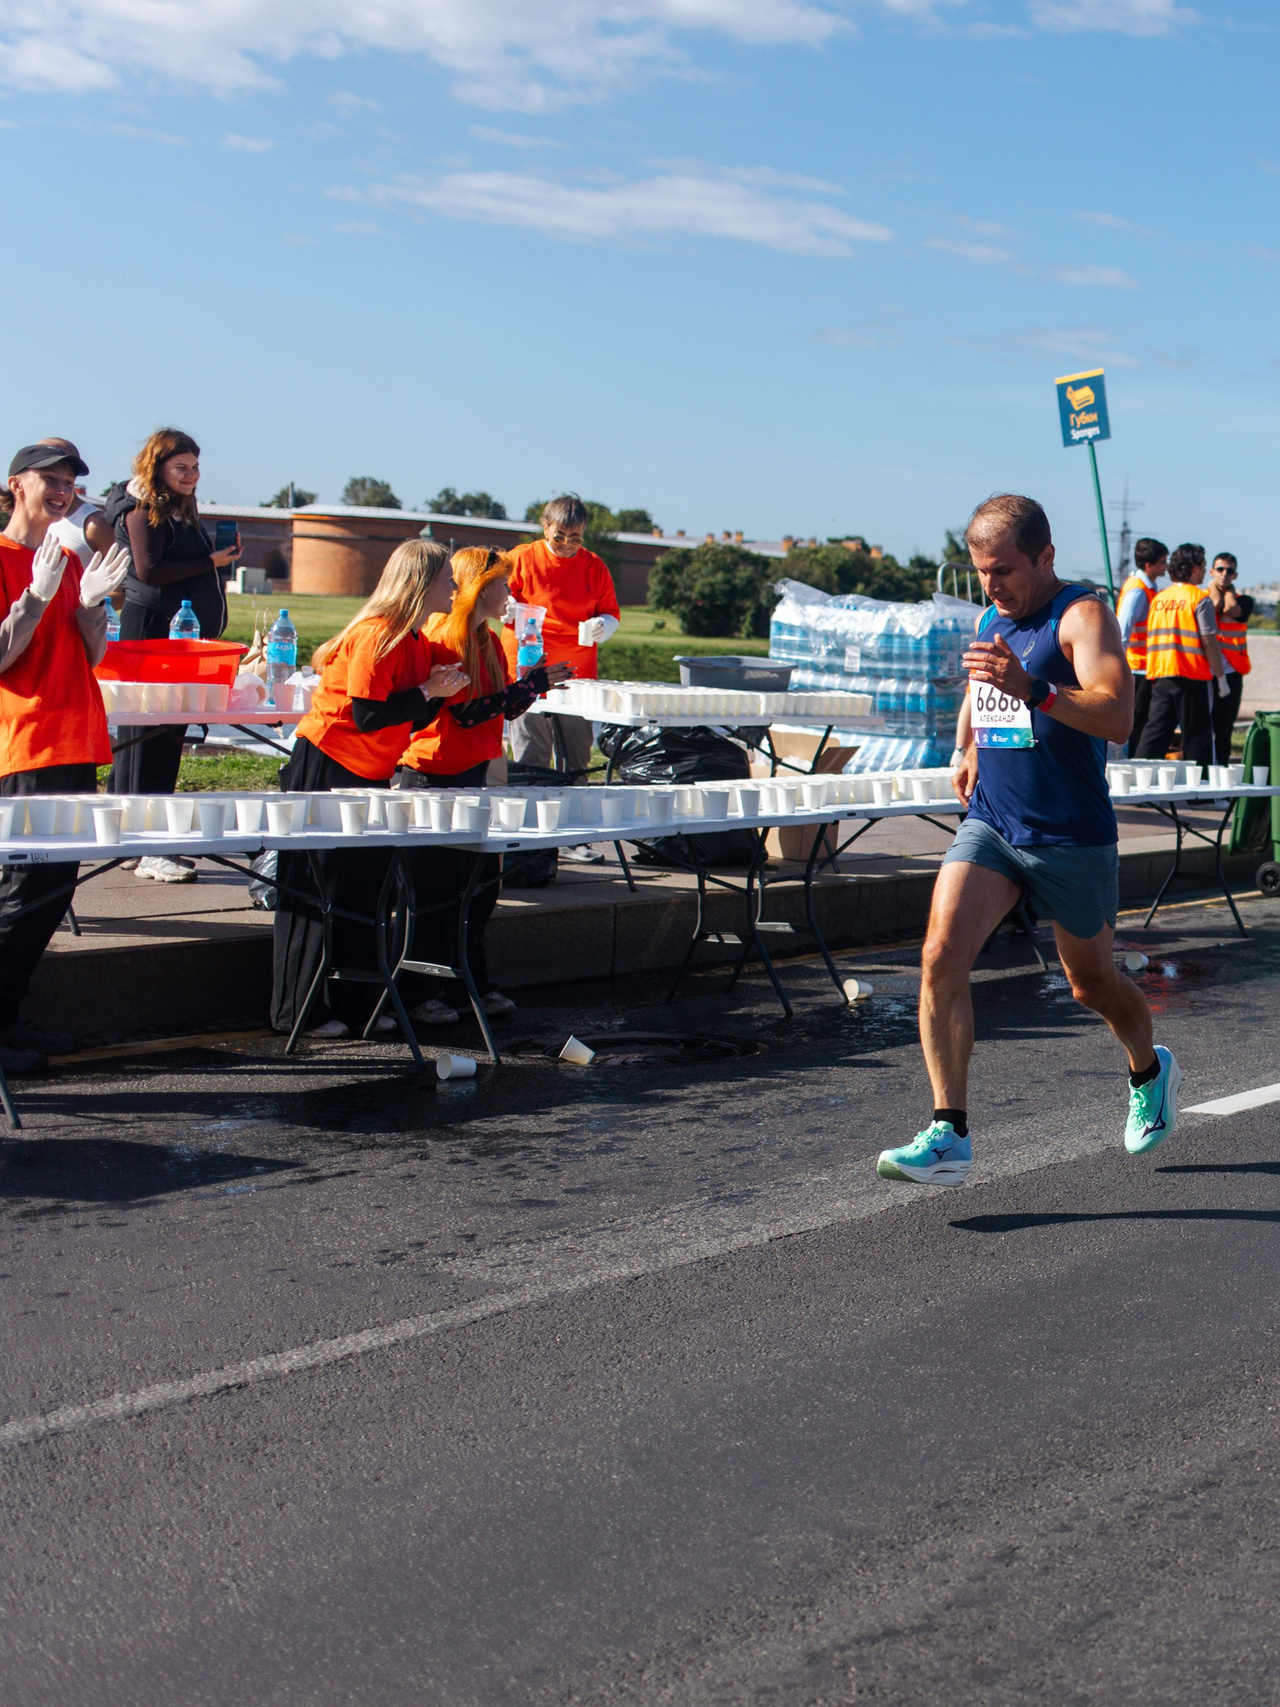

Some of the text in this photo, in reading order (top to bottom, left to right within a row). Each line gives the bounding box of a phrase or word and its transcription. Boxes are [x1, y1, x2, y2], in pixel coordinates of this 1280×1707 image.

[1069, 411, 1098, 428] Губки
[1070, 426, 1100, 441] Sponges
[1154, 599, 1187, 613] СУДЬЯ
[979, 714, 1016, 724] АЛЕКСАНДР
